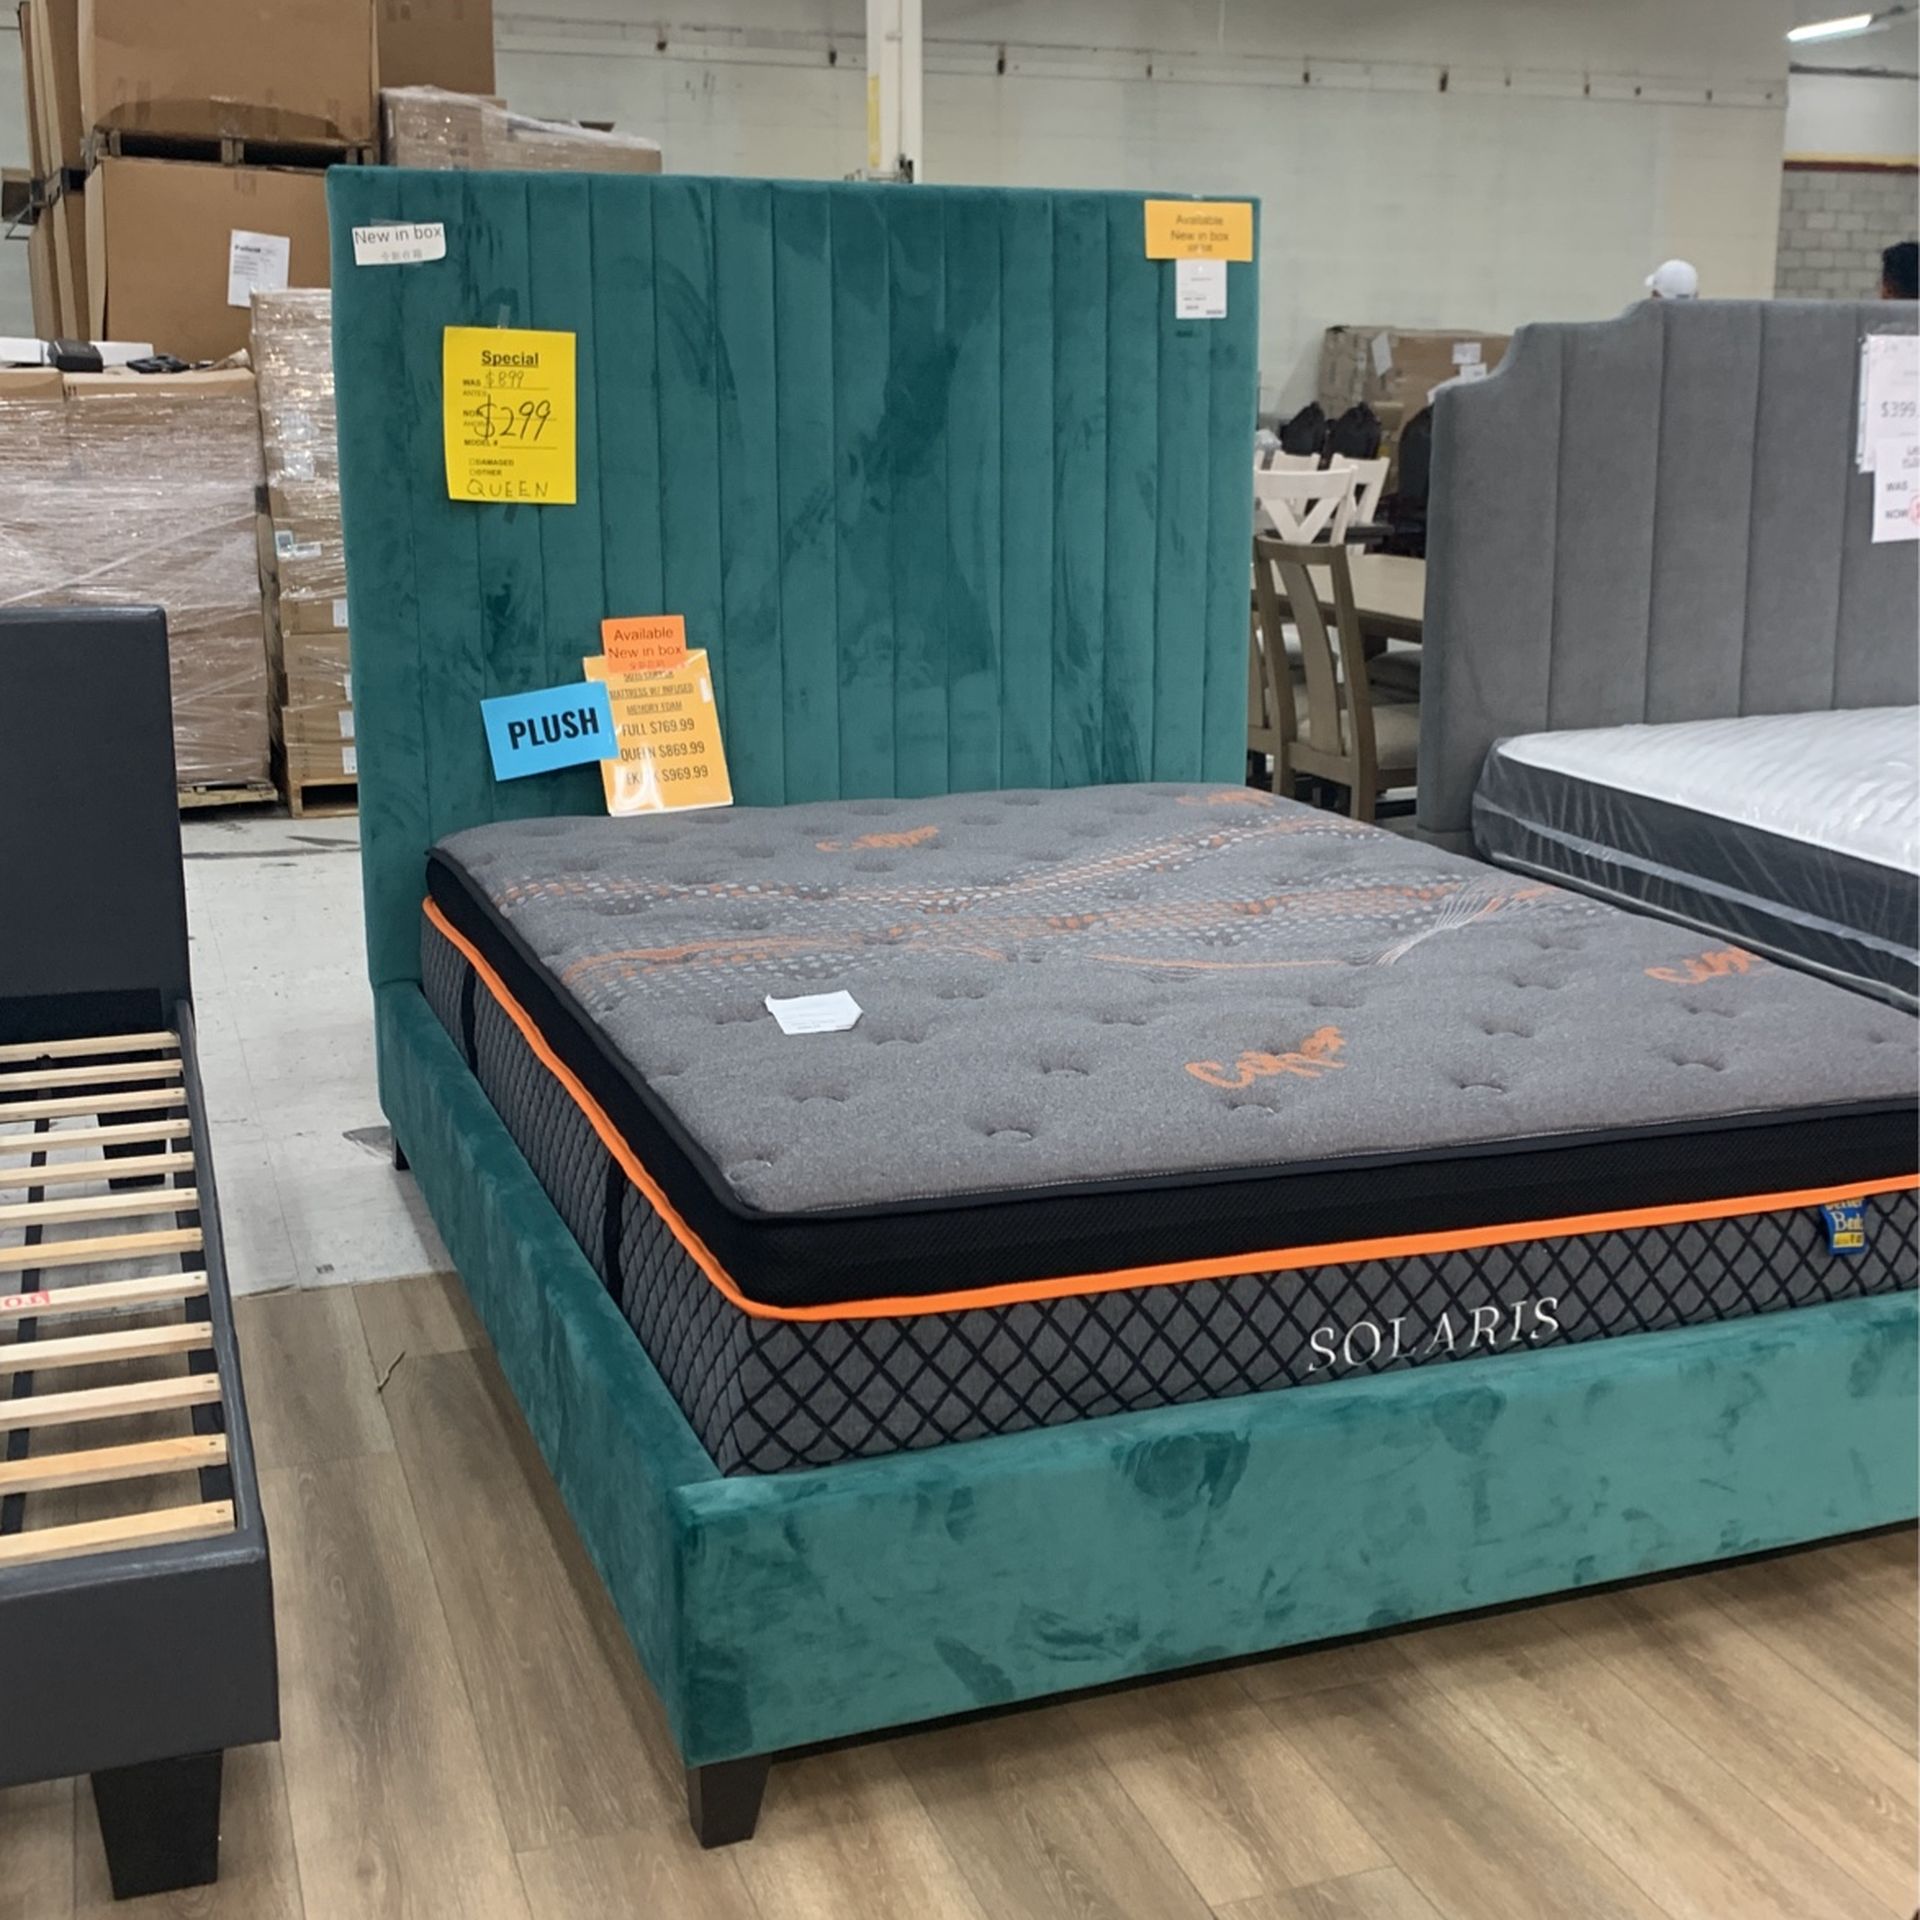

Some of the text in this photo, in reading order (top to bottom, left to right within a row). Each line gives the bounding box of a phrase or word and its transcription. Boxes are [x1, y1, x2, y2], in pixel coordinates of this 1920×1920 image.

[355, 225, 442, 244] New in box
[481, 350, 539, 366] Special
[474, 394, 551, 441] $299
[464, 439, 491, 447] MODEL
[467, 478, 549, 497] QUEEN
[614, 626, 674, 641] Available
[608, 644, 682, 659] New in box
[626, 702, 660, 715] MEMORY
[507, 707, 600, 750] PLUSH
[622, 718, 695, 736] FULL $769.99
[658, 741, 705, 758] $869.99
[661, 764, 709, 782] $969.99
[1308, 1297, 1560, 1371] SOLARIS
